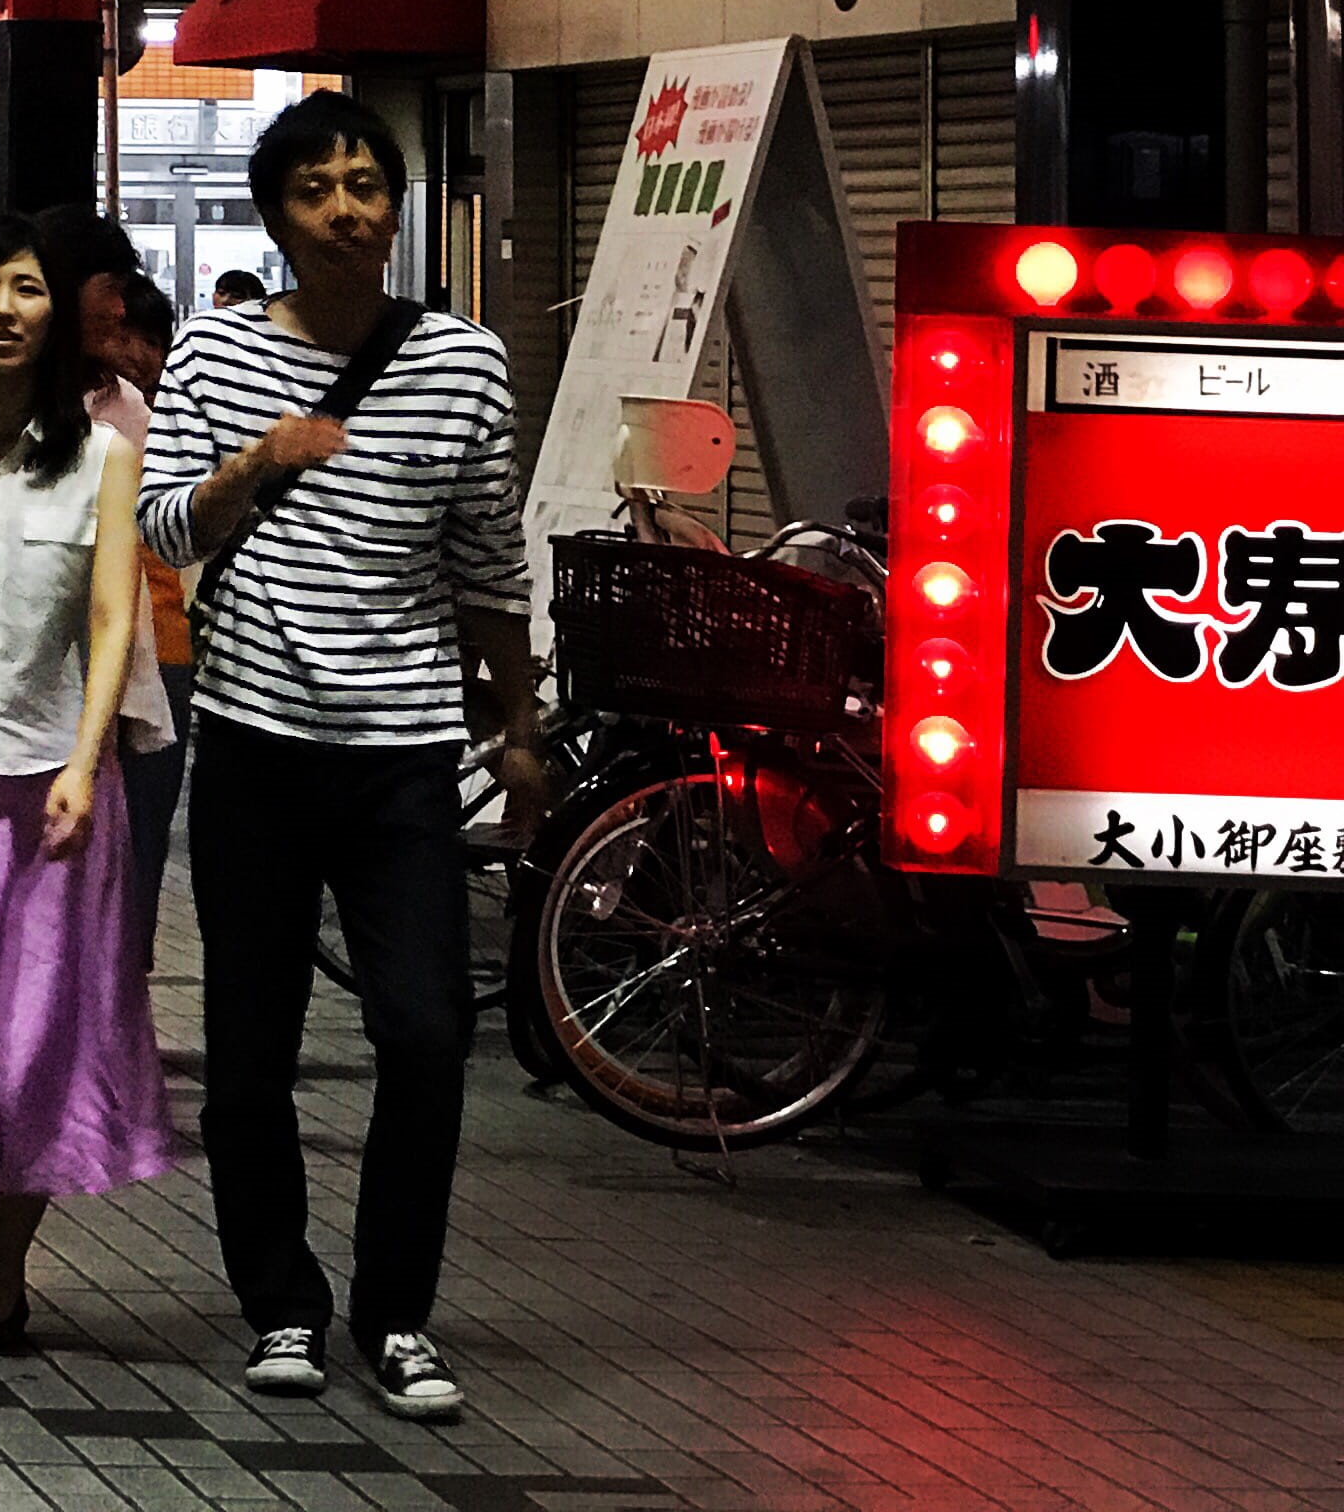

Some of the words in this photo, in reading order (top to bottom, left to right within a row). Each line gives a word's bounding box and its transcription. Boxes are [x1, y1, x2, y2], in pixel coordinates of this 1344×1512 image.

[1083, 362, 1119, 397] 酒
[1199, 364, 1271, 396] ビール
